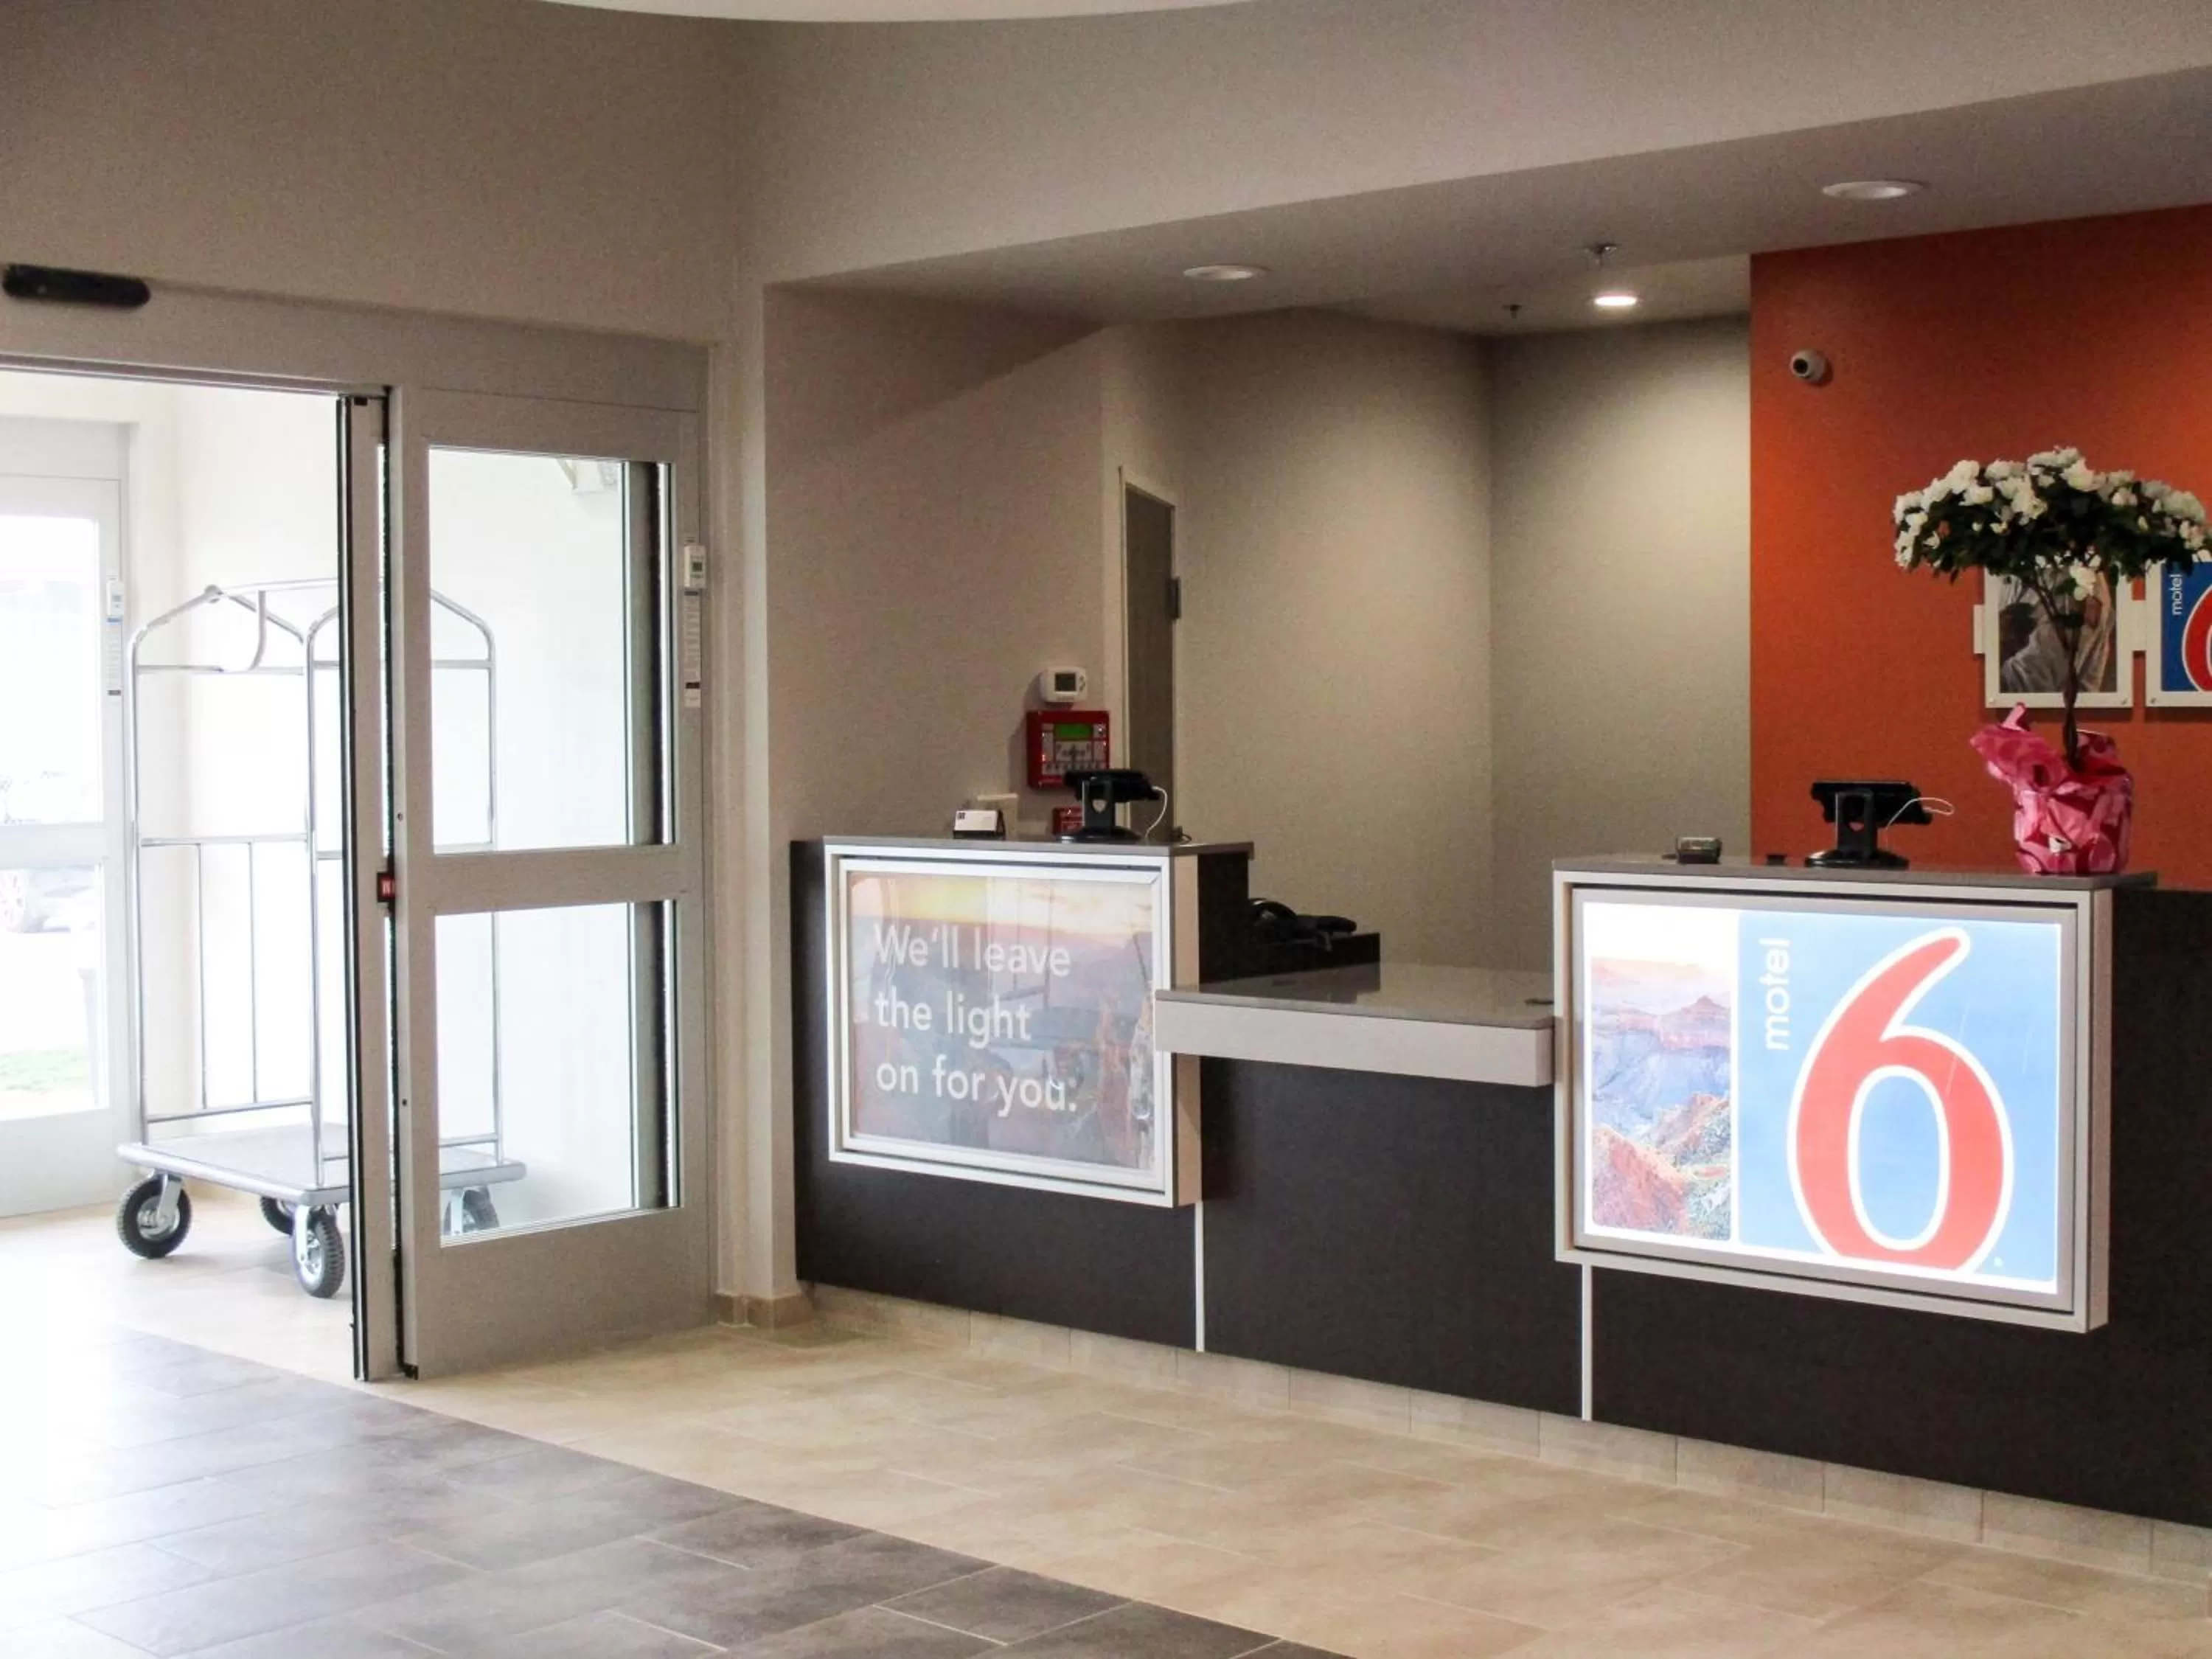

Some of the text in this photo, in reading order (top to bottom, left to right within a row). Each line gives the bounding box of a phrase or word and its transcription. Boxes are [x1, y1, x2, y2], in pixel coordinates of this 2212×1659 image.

[2168, 574, 2183, 616] motel
[873, 922, 1072, 977] We'll leave
[874, 987, 1032, 1050] the light
[875, 1054, 1078, 1119] on for you.
[1758, 926, 2014, 1276] motel 6
